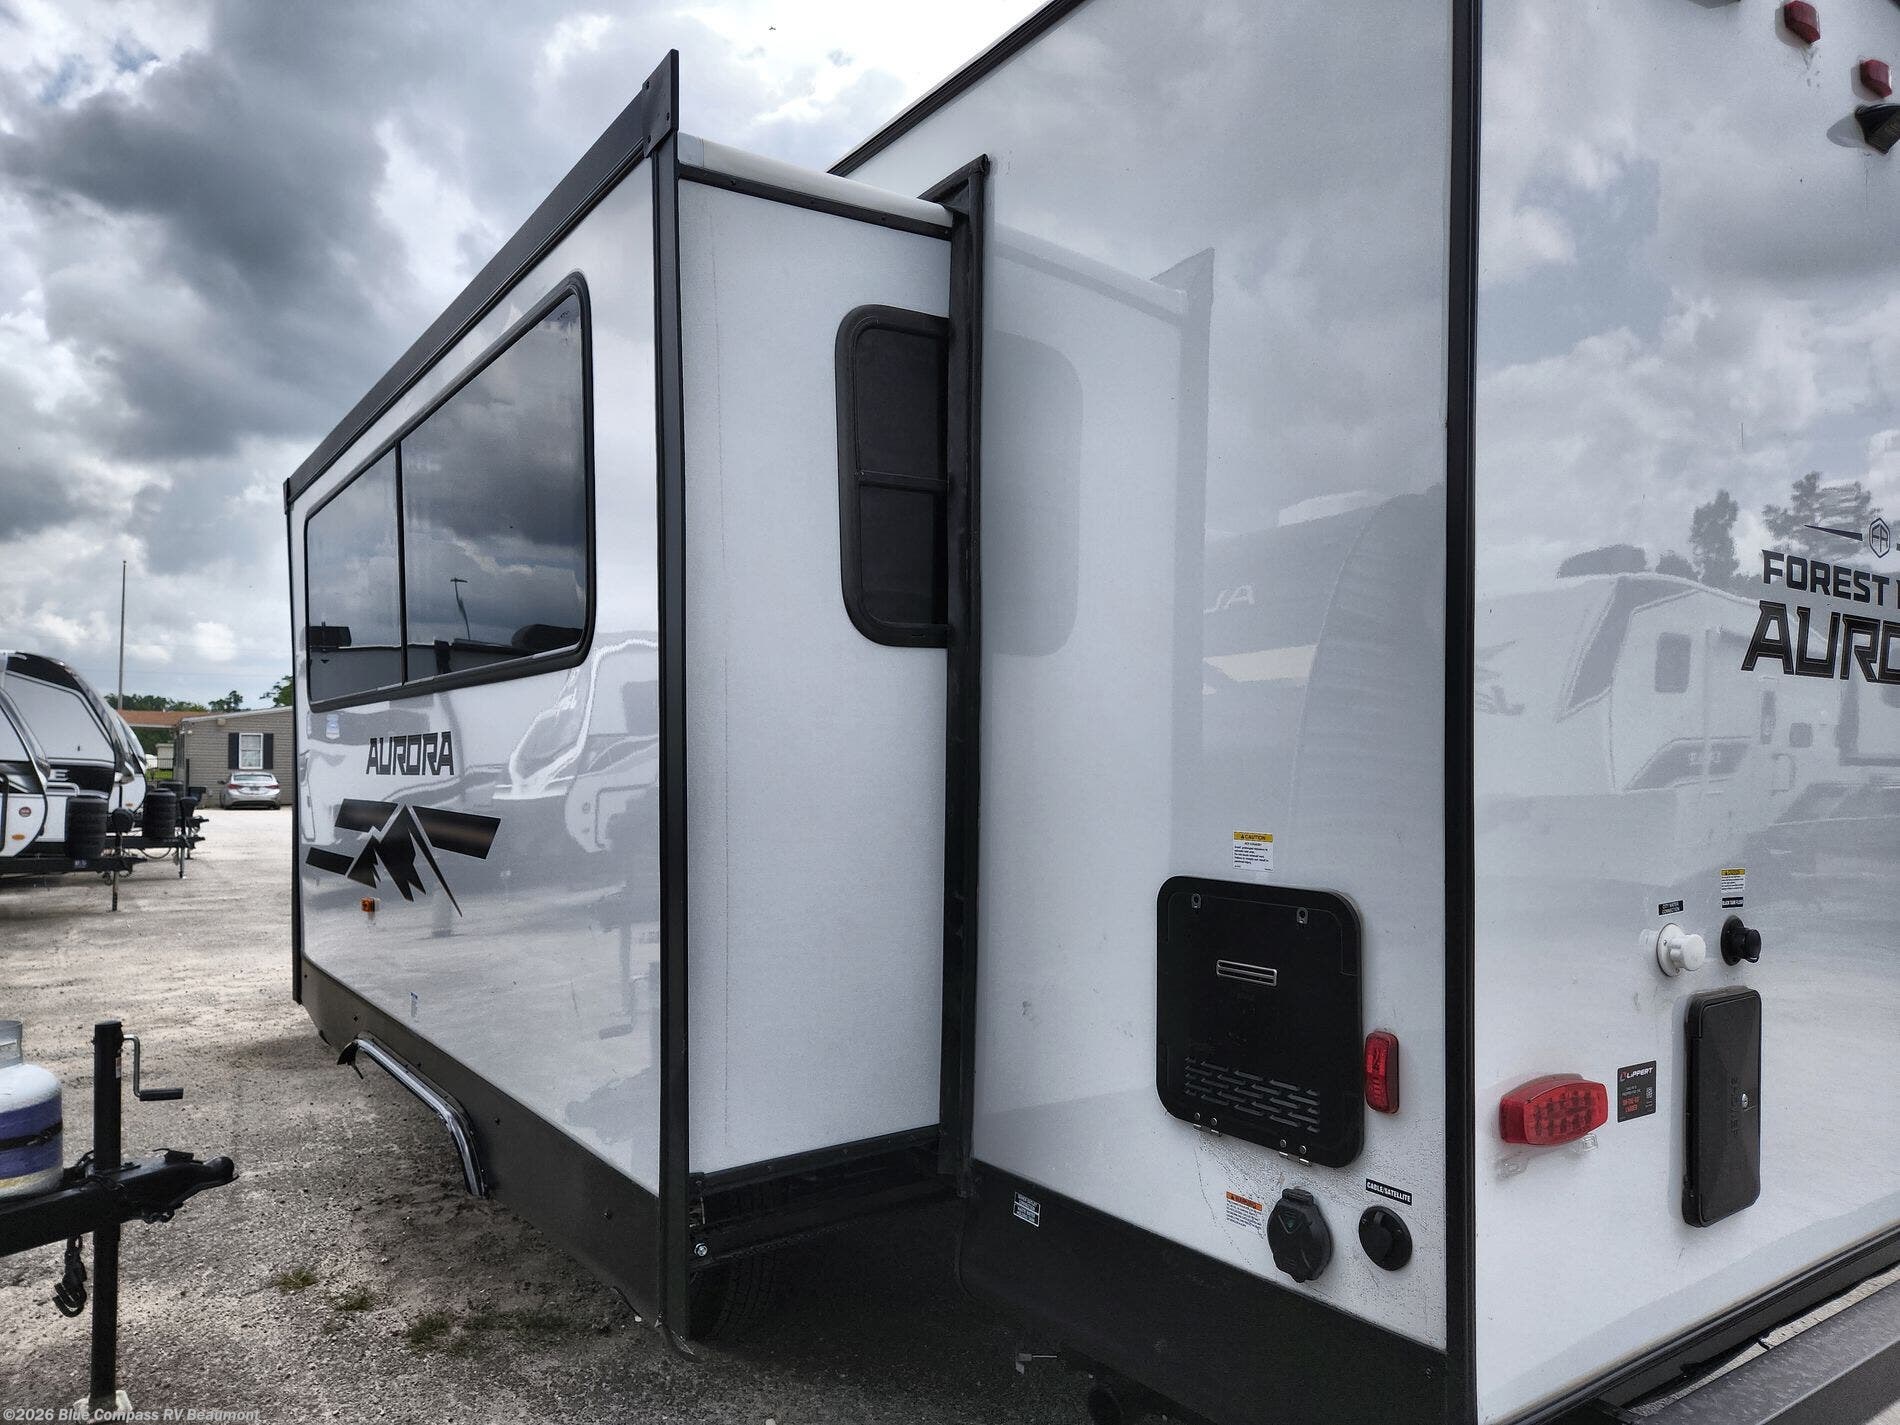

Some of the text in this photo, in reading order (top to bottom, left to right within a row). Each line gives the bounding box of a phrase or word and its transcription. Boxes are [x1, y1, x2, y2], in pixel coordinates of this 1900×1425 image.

[1762, 549, 1890, 606] FOREST
[366, 731, 454, 775] AURORA
[1366, 1181, 1411, 1203] CABLE/SATELLITE
